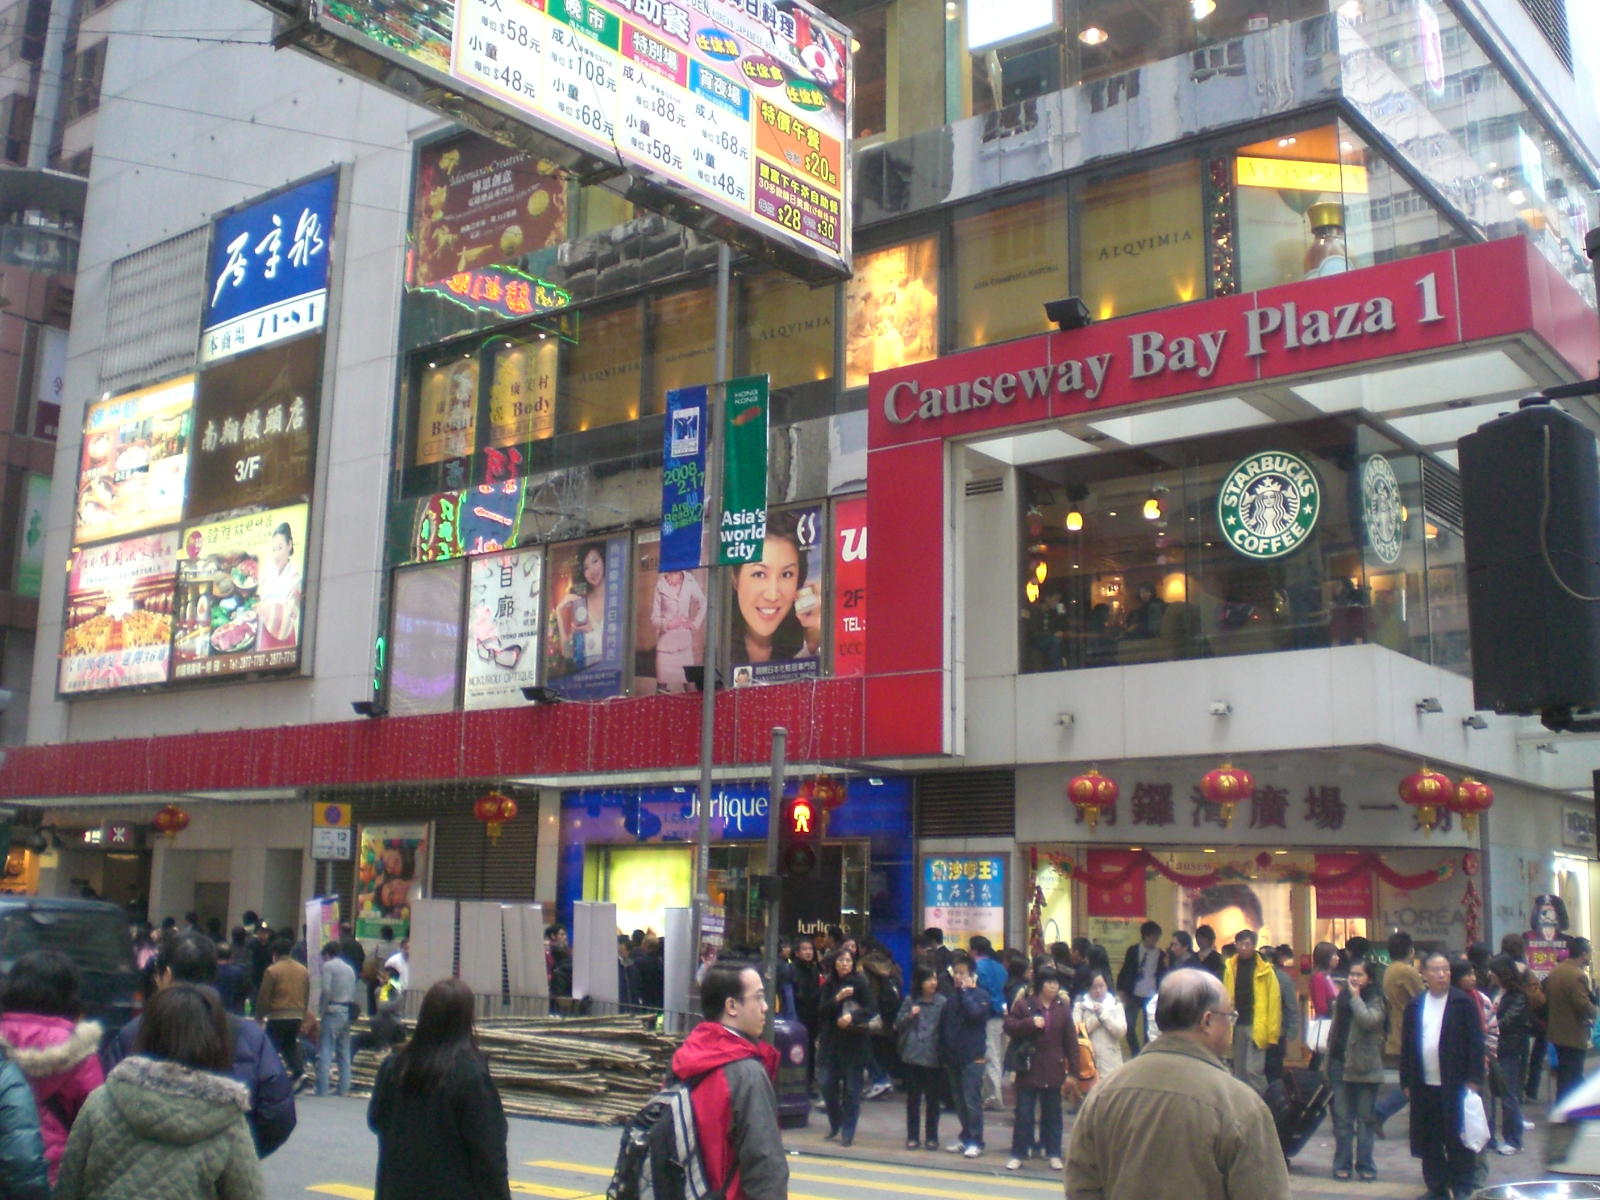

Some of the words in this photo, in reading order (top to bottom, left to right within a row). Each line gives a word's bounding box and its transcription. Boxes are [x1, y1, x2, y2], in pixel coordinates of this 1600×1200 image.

[468, 35, 499, 62] 小童
[552, 78, 580, 102] 小童
[625, 113, 651, 138] 小童
[761, 100, 821, 152] 特價午餐
[692, 147, 716, 170] 小童
[777, 203, 801, 232] $28
[816, 219, 835, 241] $30
[883, 351, 1115, 425] Causeway
[1128, 329, 1228, 380] Bay
[1244, 296, 1397, 357] Plaza
[1415, 271, 1446, 324] 1
[734, 389, 759, 397] HONG
[734, 396, 758, 404] KONG
[512, 396, 551, 417] Body
[234, 455, 261, 482] 3/F
[663, 461, 698, 486] 2008
[1223, 455, 1315, 508] STARBUCKS
[721, 507, 766, 527] Asia's
[720, 523, 766, 542] world
[1233, 520, 1307, 553] COFFEE
[726, 541, 757, 561] city
[842, 588, 865, 609] 2F
[839, 641, 863, 657] UCC
[684, 790, 770, 832] Jrlique
[337, 831, 347, 842] 12
[336, 847, 346, 857] 12
